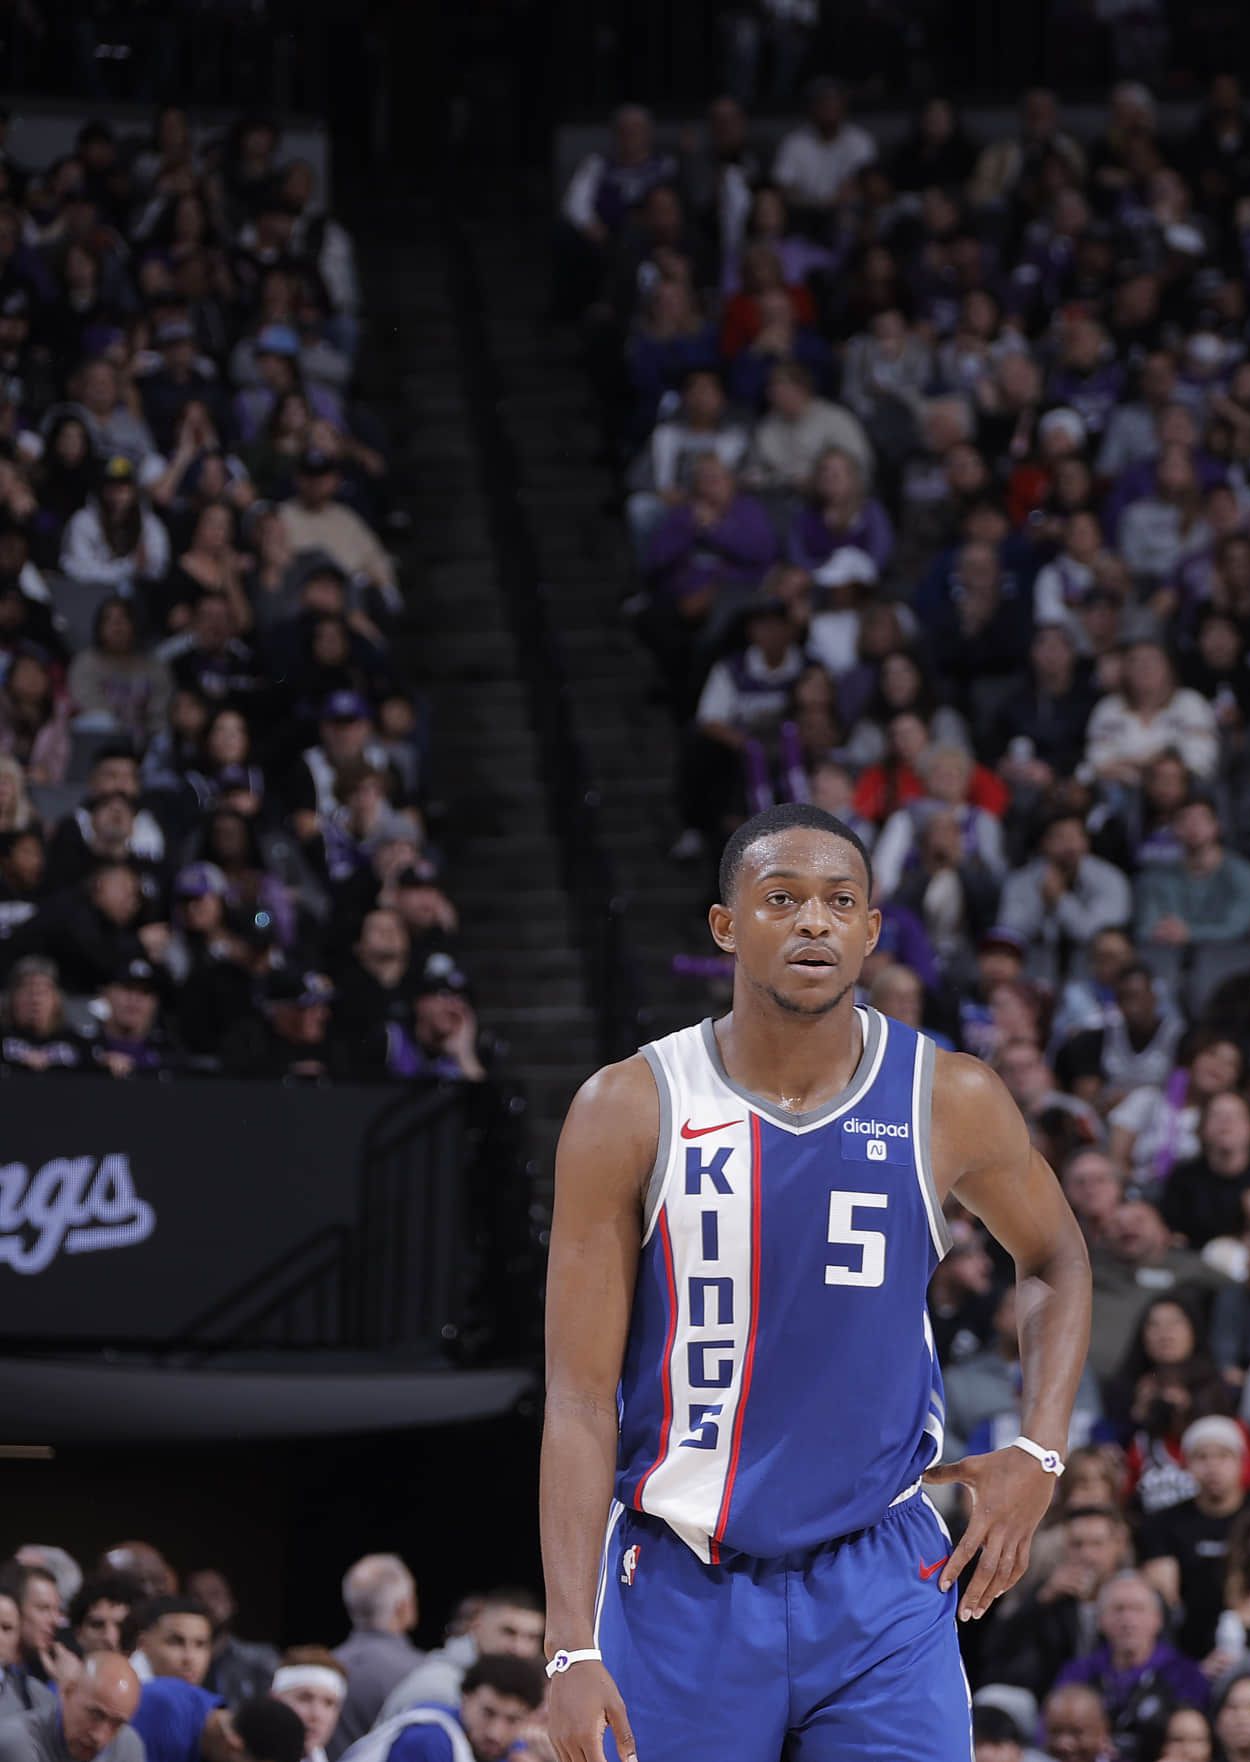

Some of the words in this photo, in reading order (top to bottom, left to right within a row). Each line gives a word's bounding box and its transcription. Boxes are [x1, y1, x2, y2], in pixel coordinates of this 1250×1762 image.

[843, 1117, 909, 1139] dialpad
[824, 1190, 889, 1288] 5
[678, 1146, 735, 1450] KINGS
